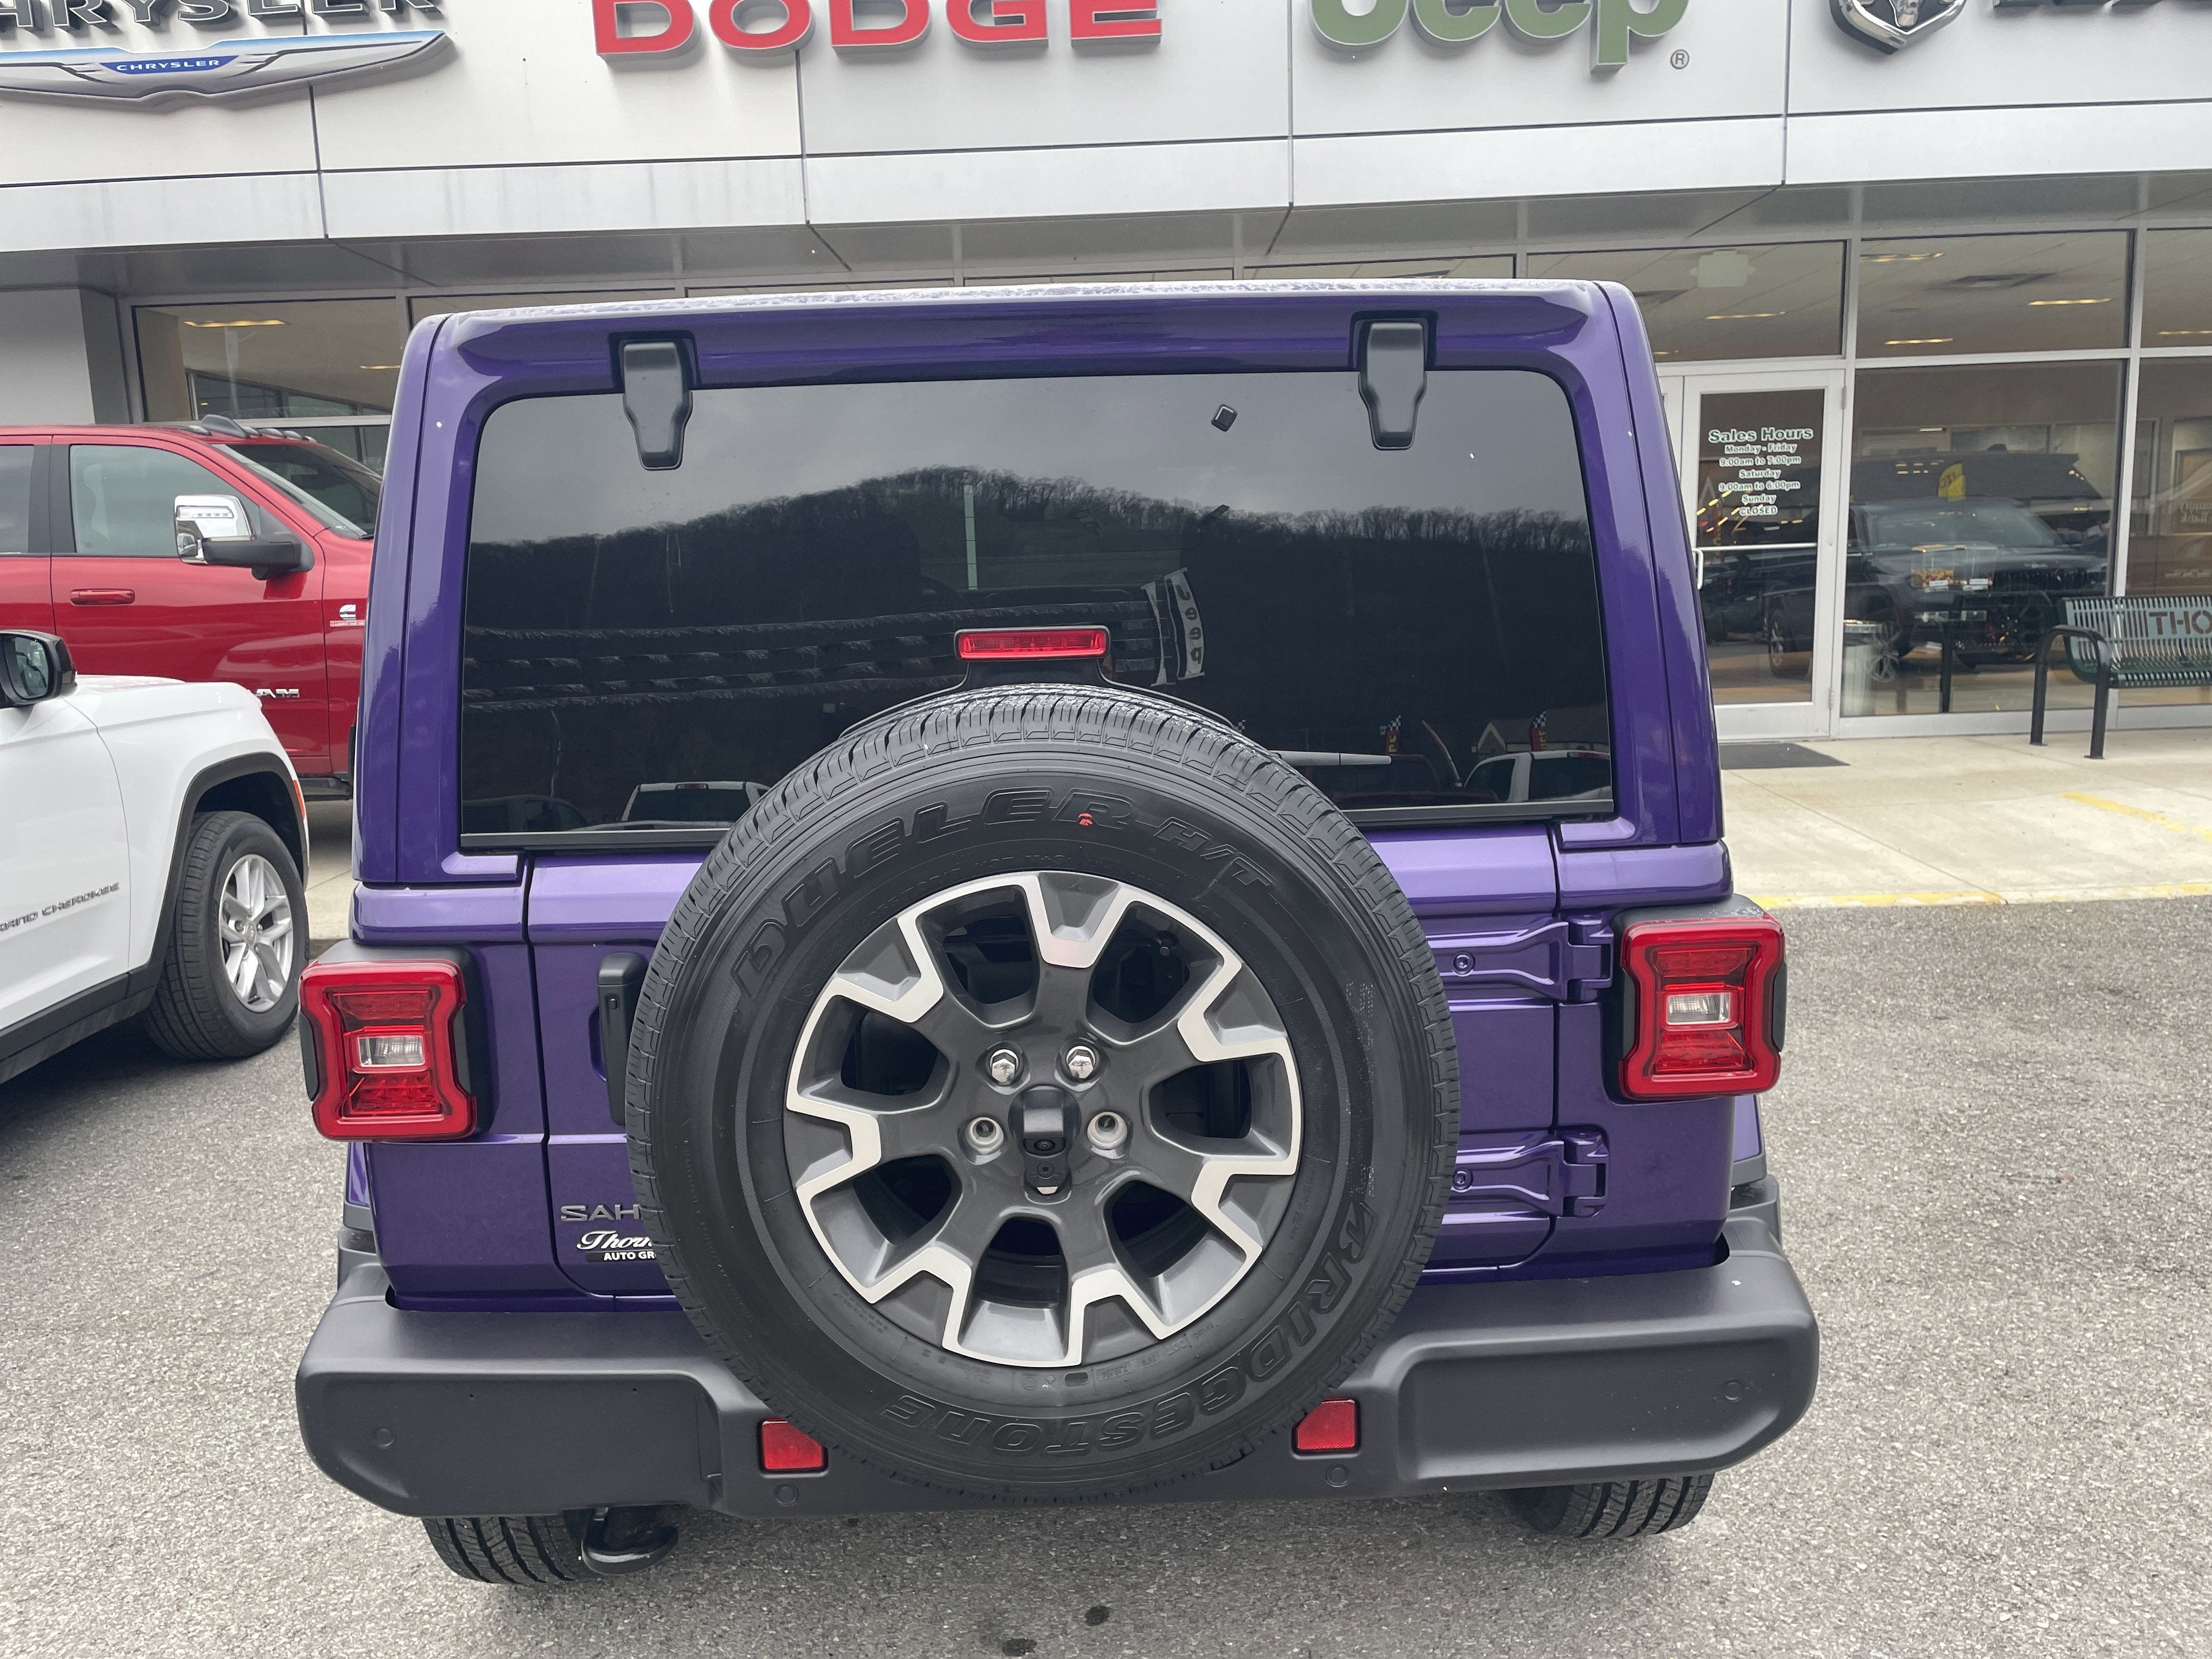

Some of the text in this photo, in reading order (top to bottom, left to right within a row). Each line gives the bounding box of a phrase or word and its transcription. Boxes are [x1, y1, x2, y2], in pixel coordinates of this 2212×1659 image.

[596, 0, 1162, 57] DODGE
[116, 59, 220, 71] CHRYSLER
[1708, 427, 1814, 443] Sales Hours
[1725, 444, 1761, 454] Monday
[1767, 443, 1798, 453] Friday
[1754, 456, 1766, 466] to
[1739, 468, 1782, 479] Saturday
[1754, 481, 1765, 490] to
[1741, 493, 1777, 504] Sunday
[1739, 505, 1778, 516] CLOSED
[255, 689, 300, 698] AM
[42, 882, 120, 917] CHEROKEE
[561, 1204, 640, 1222] SAH
[604, 1251, 657, 1261] AUTO GR
[881, 1199, 1377, 1454] BRIDGESTONE
